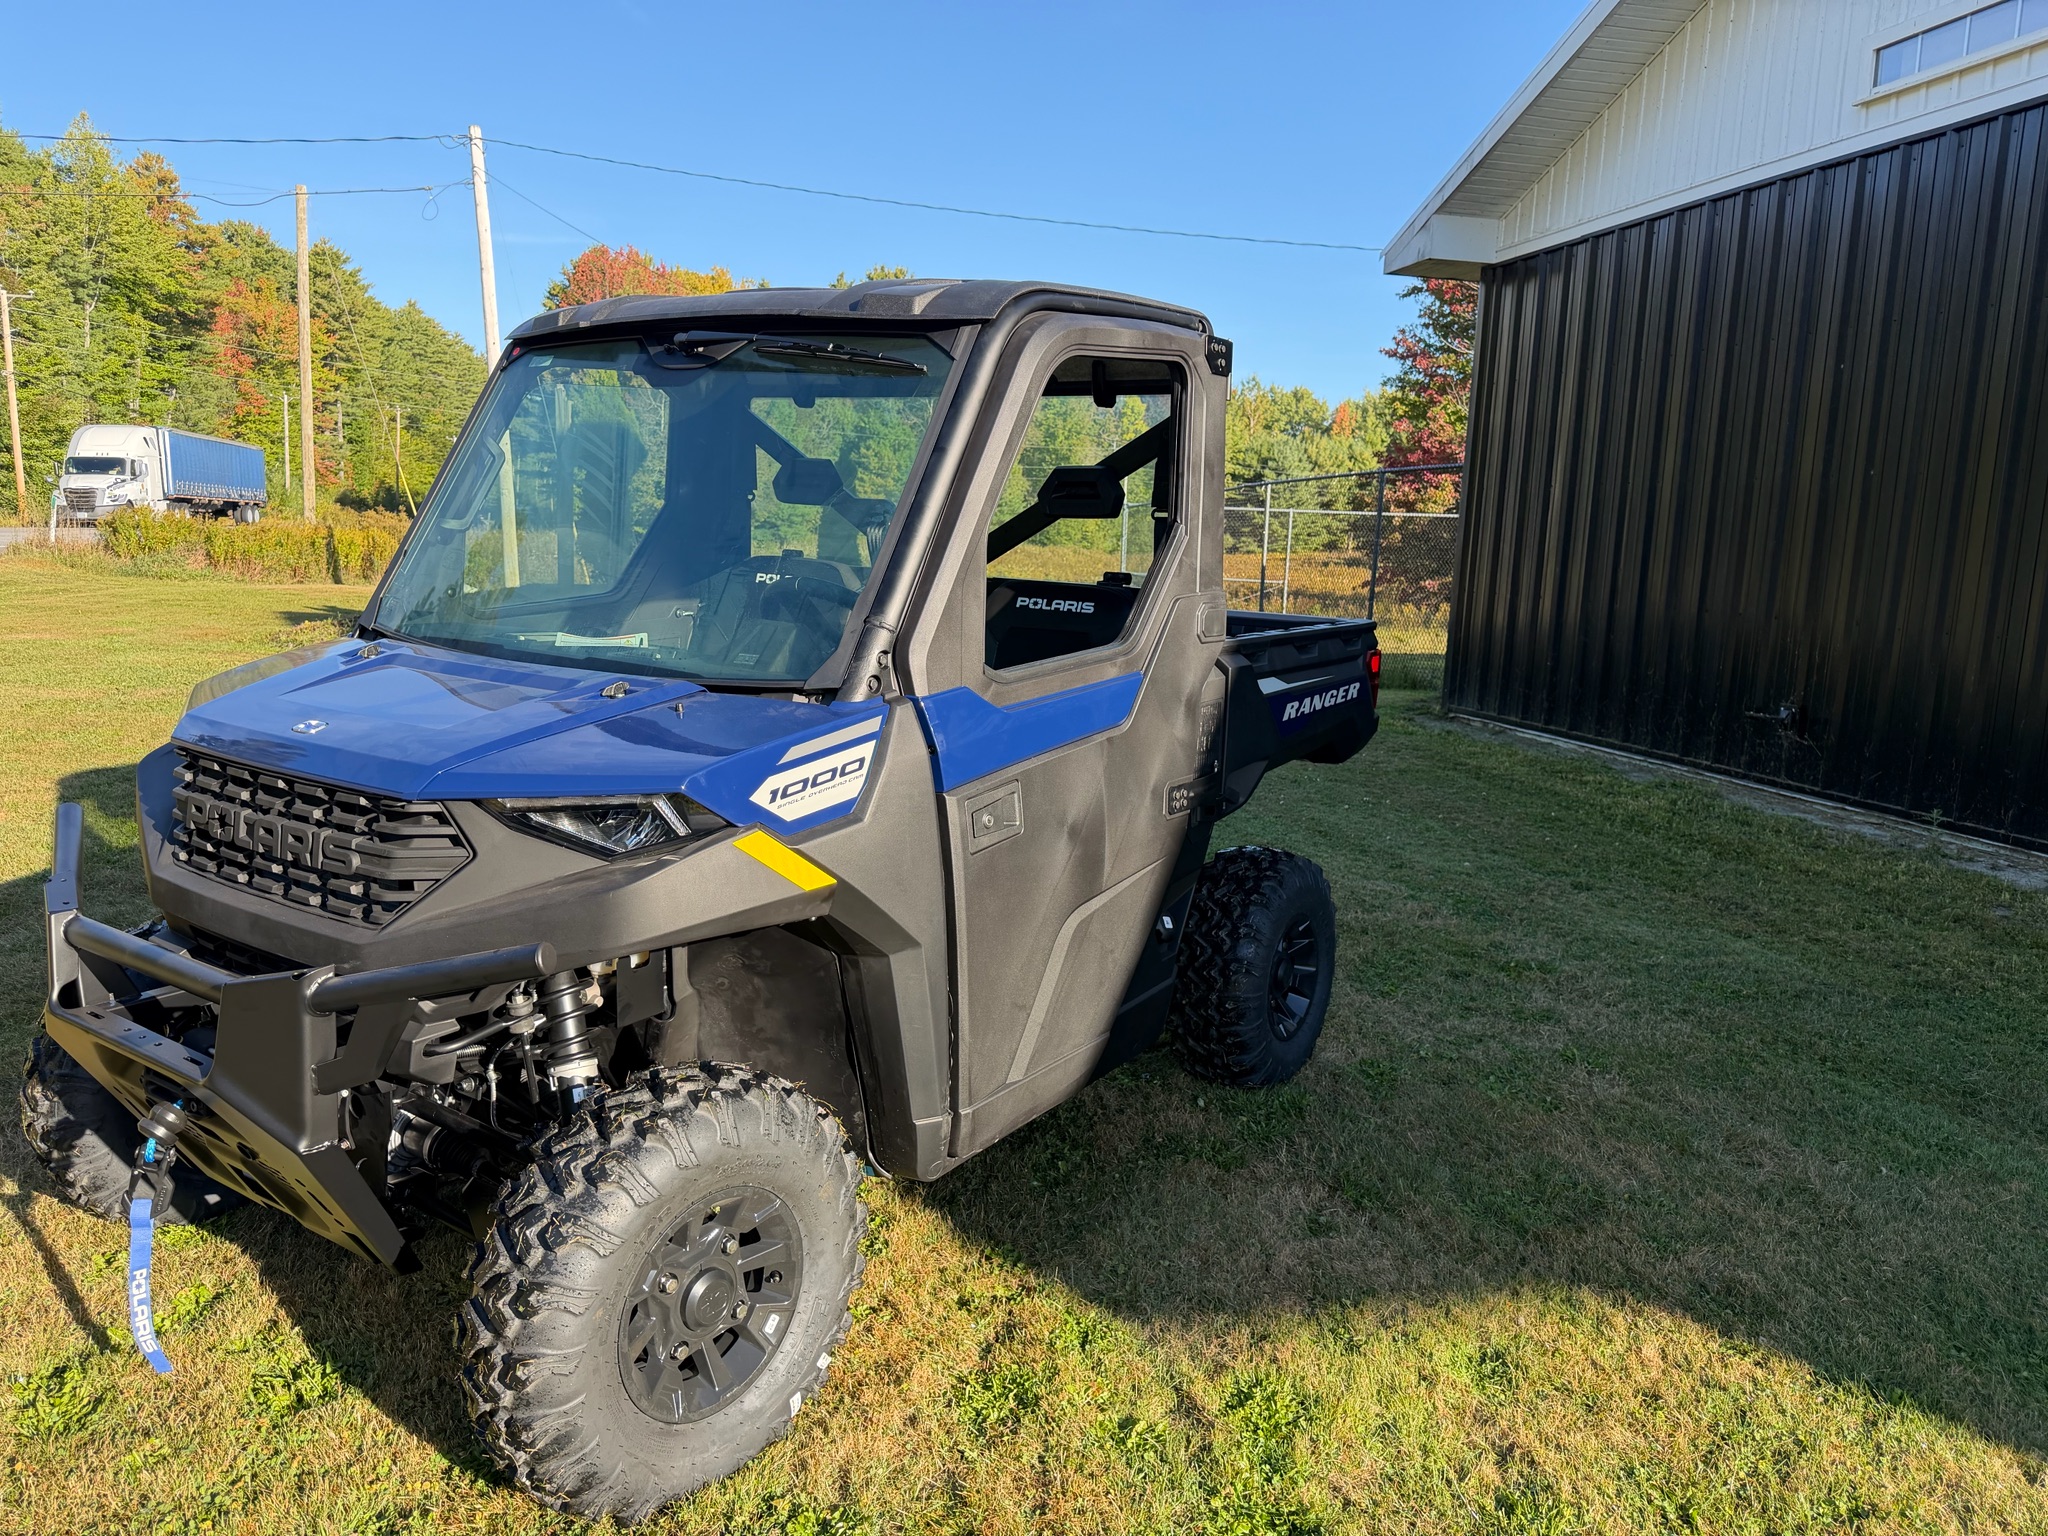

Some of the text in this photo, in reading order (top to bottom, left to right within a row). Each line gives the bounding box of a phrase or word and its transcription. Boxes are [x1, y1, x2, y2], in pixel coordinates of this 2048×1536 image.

[1016, 597, 1095, 614] POLARIS
[1282, 682, 1360, 722] RANGER
[768, 756, 866, 805] 1000
[777, 795, 806, 810] SINGLE
[185, 792, 361, 876] POLARIS
[131, 1268, 158, 1354] POLARIS
